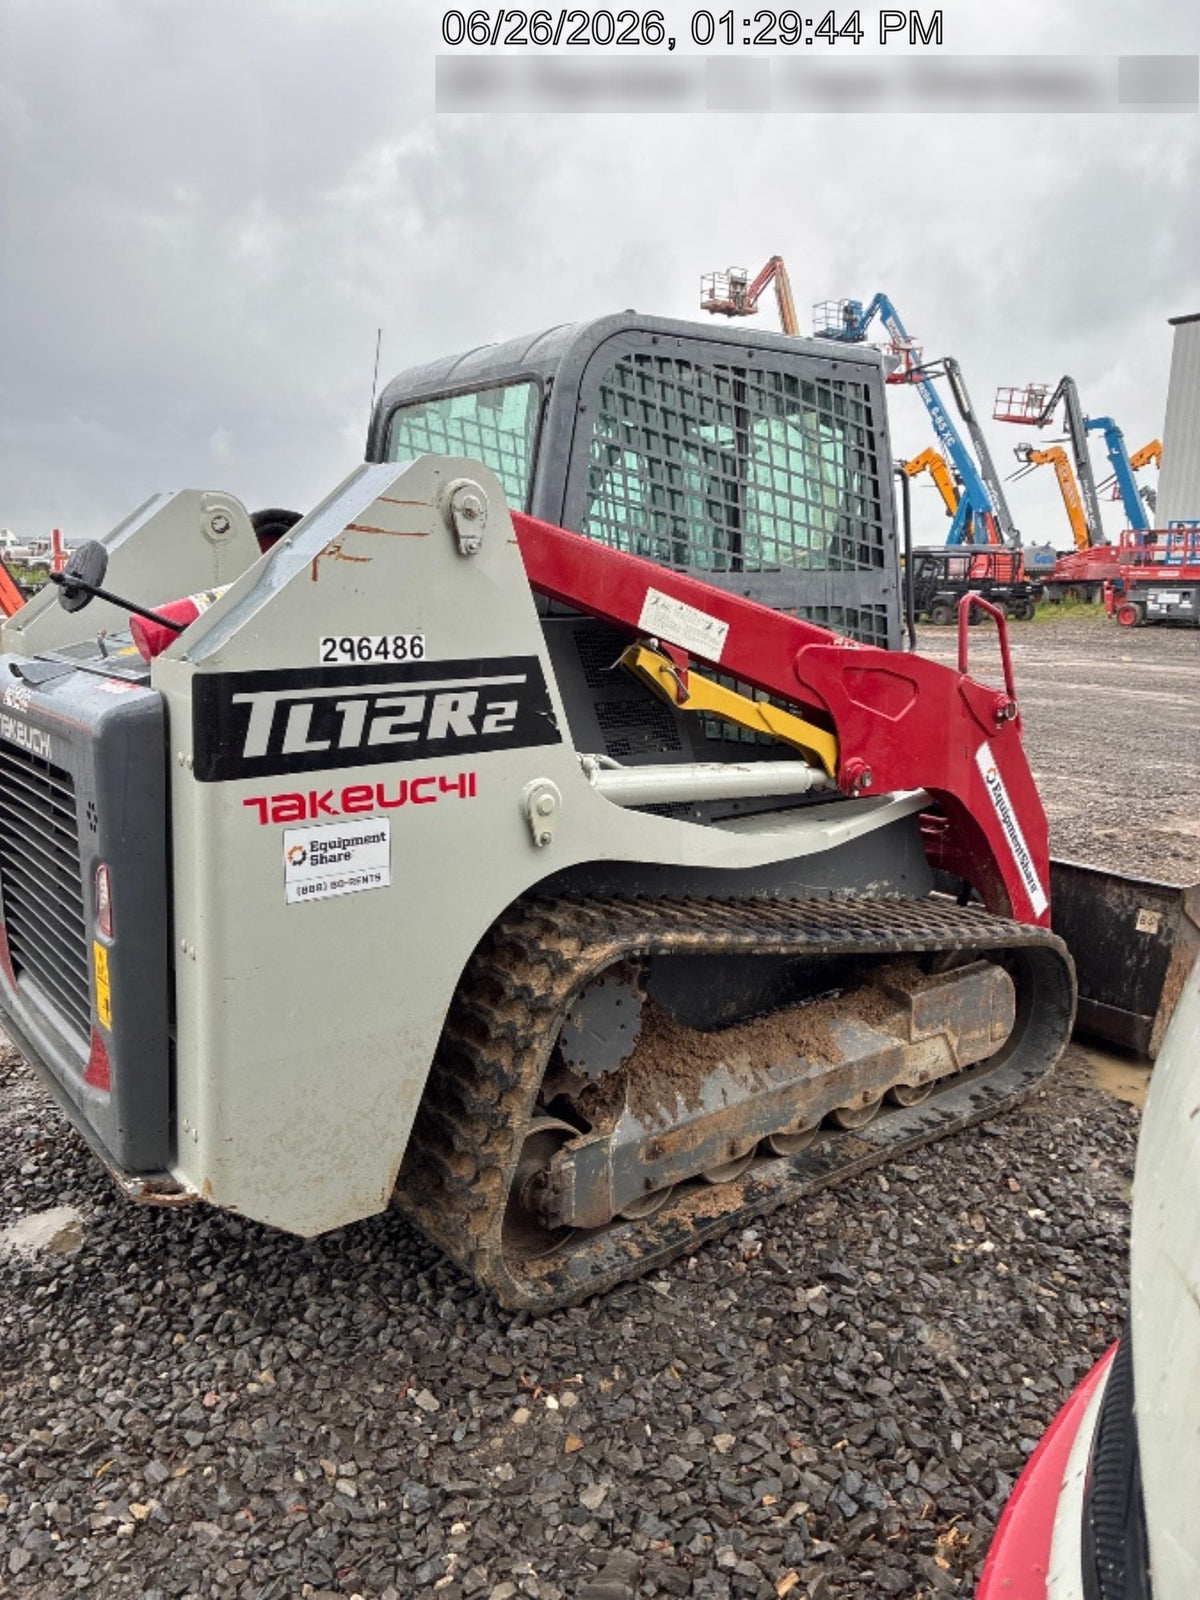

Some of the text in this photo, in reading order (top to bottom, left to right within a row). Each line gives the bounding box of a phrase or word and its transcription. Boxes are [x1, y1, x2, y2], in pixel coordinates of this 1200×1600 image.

[322, 636, 424, 662] 296486
[309, 831, 386, 852] Equipment
[310, 851, 352, 866] Share
